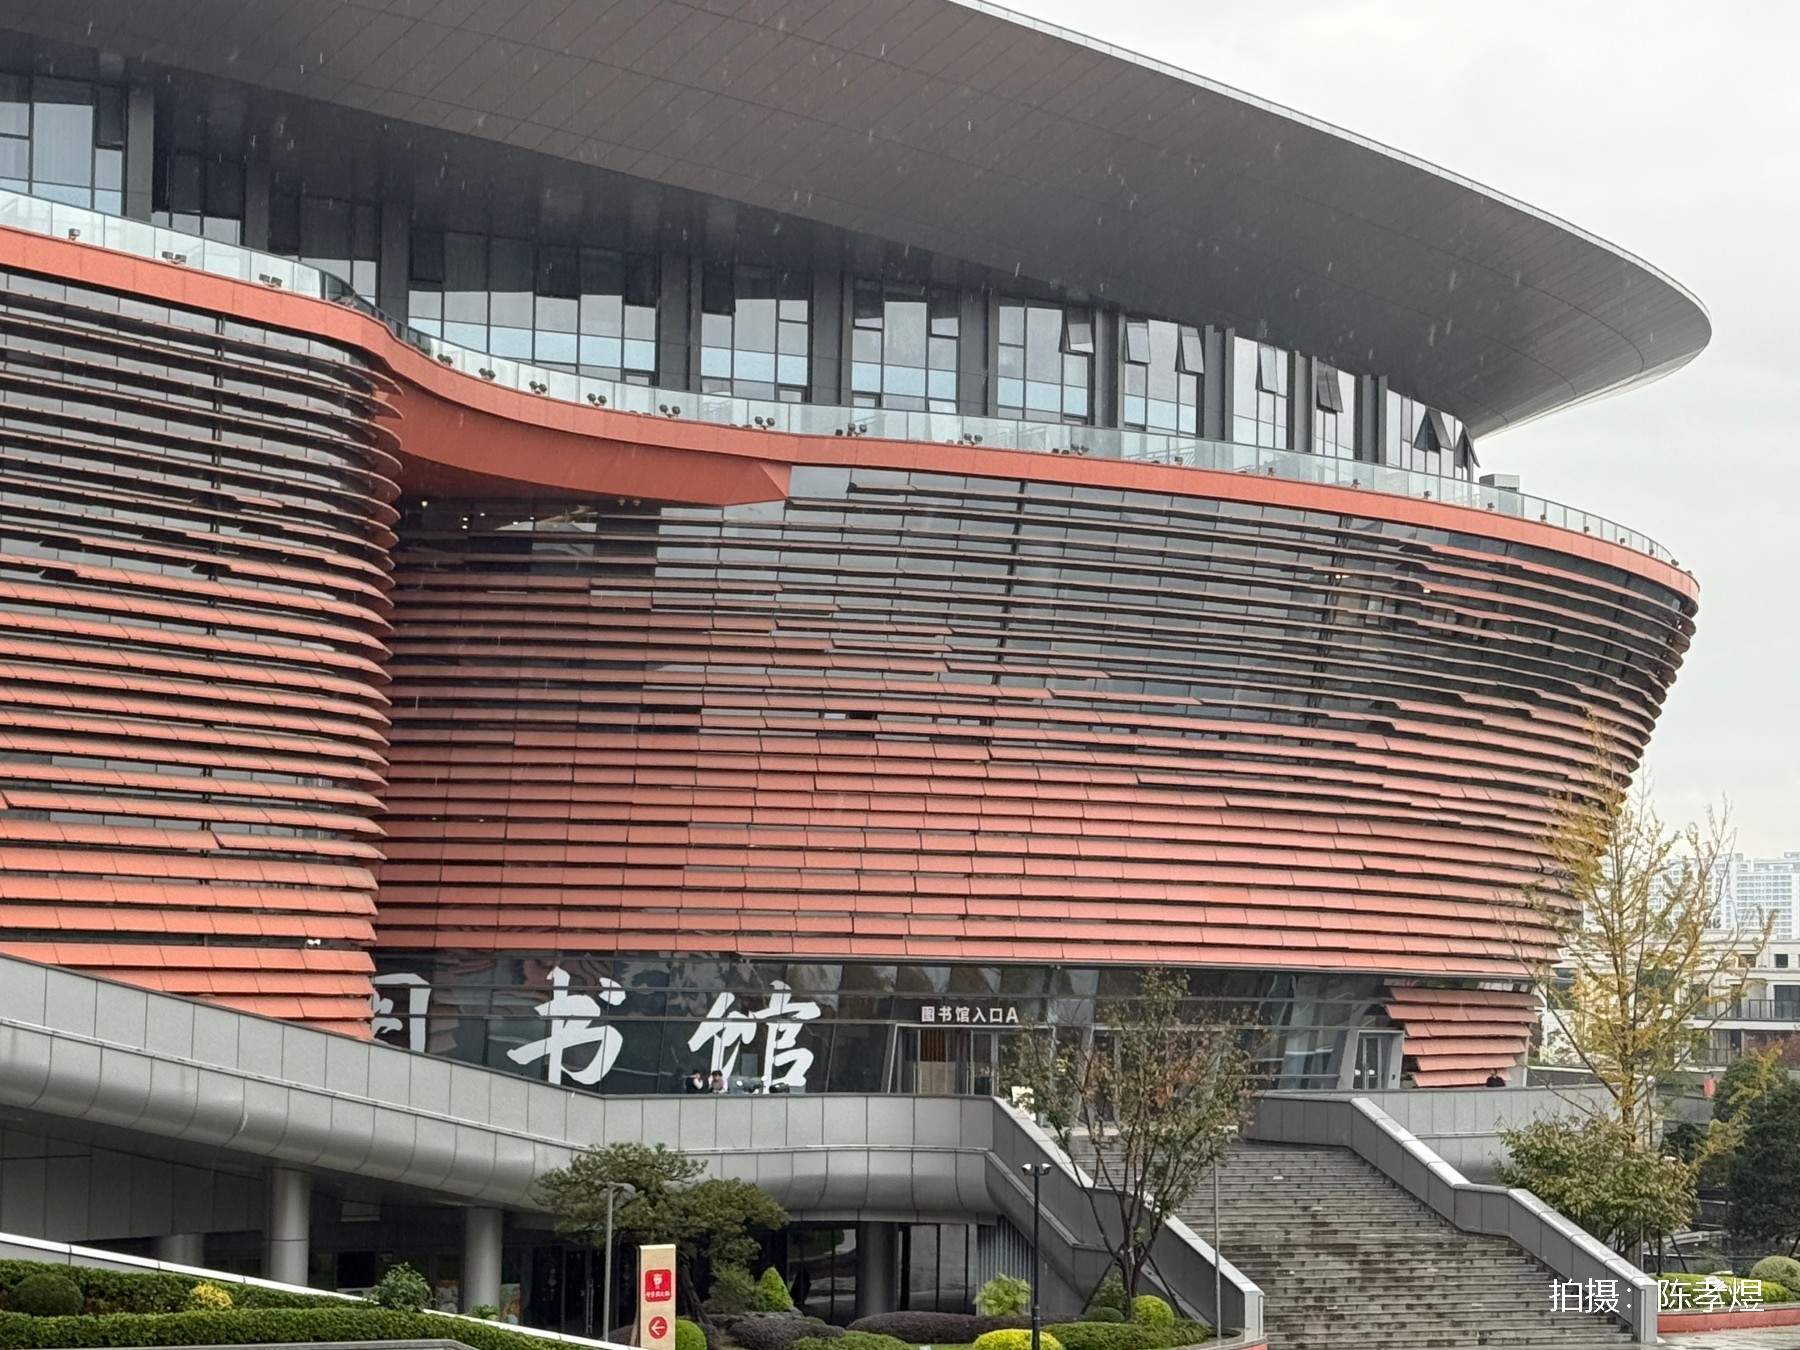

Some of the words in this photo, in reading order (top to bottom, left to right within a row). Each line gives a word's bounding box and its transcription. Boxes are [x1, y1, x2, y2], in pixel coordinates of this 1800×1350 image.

[921, 1006, 1019, 1023] 图书馆入口A
